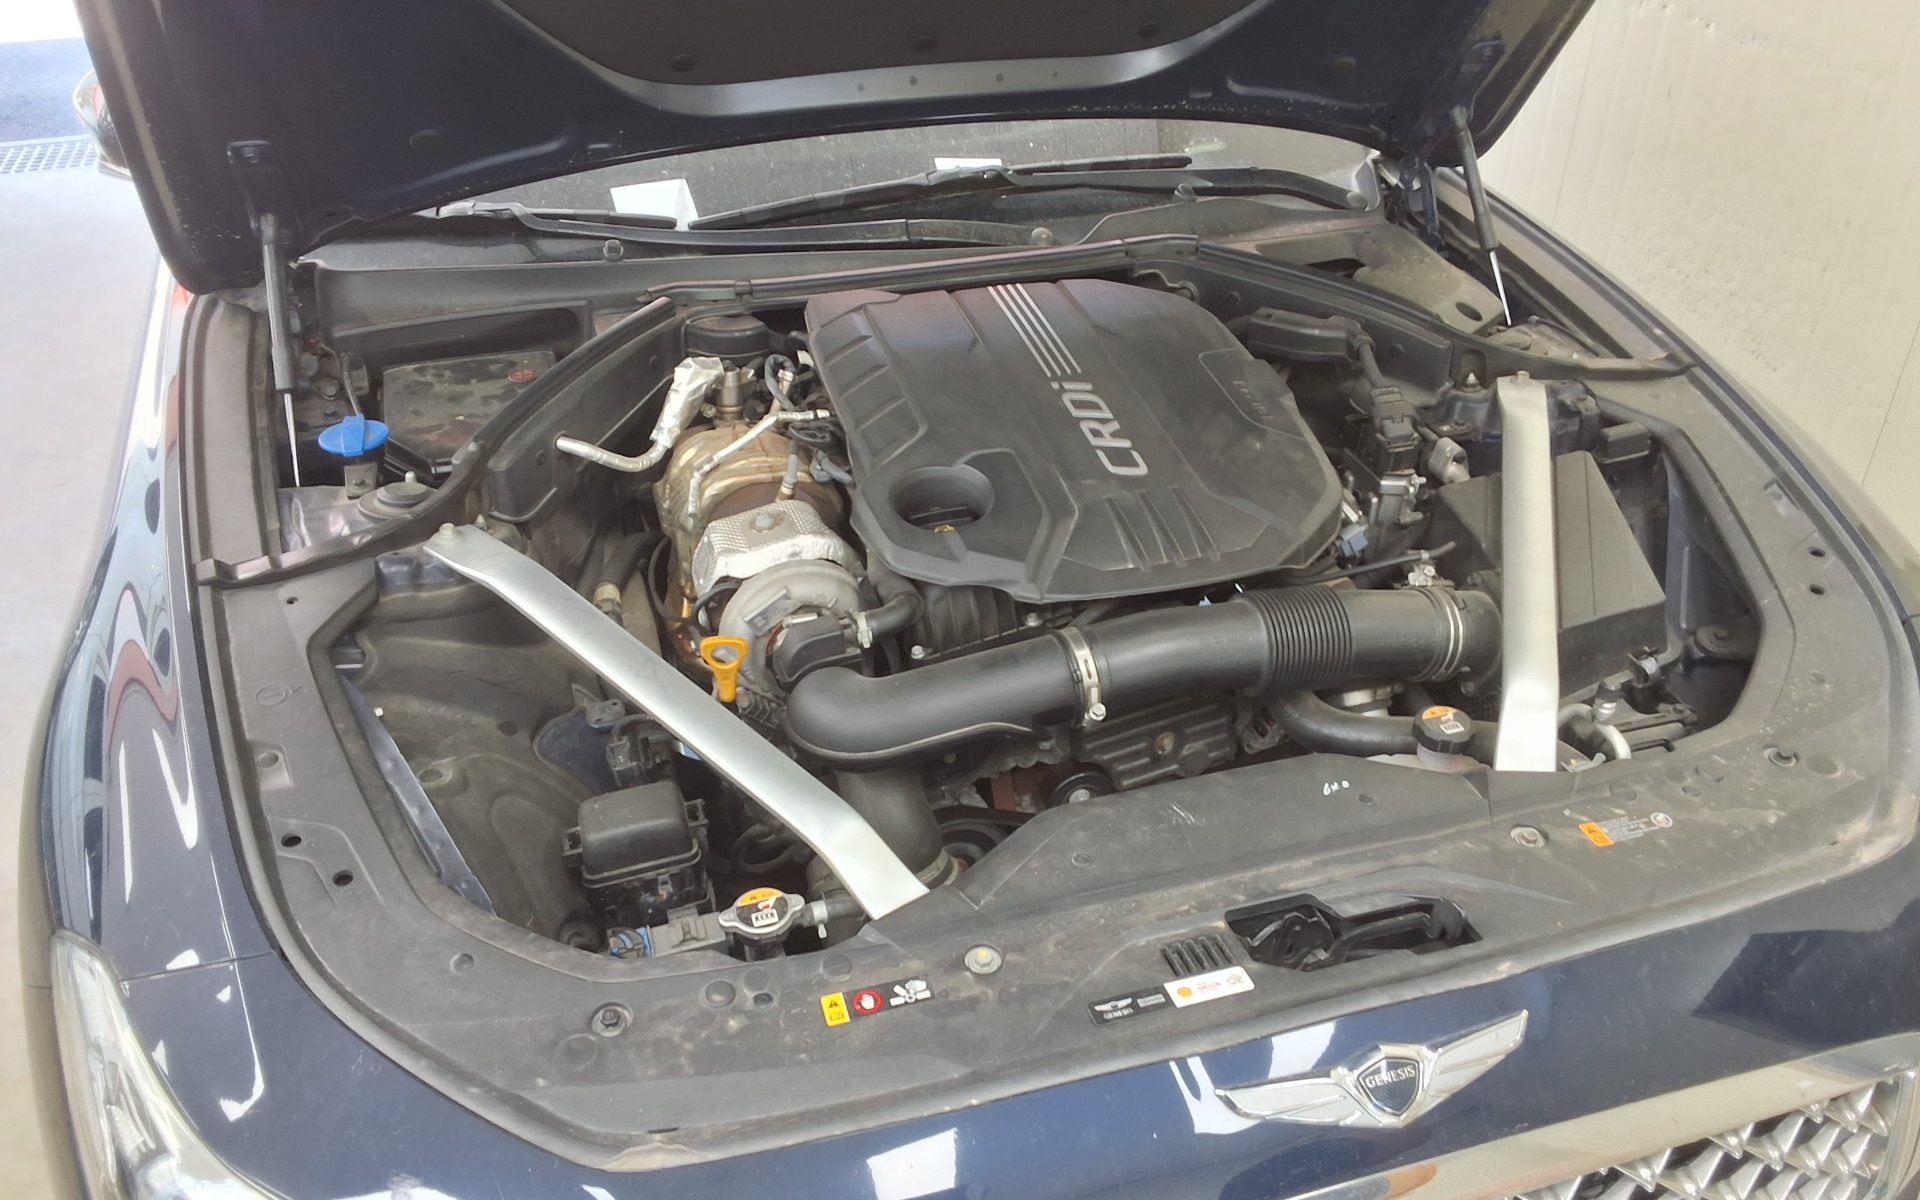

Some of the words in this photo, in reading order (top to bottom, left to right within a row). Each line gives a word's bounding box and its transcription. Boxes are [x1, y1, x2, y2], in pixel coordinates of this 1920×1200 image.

[1050, 381, 1148, 475] CRDi
[1103, 1007, 1134, 1020] GENESIS
[1365, 1064, 1416, 1089] GENESIS
